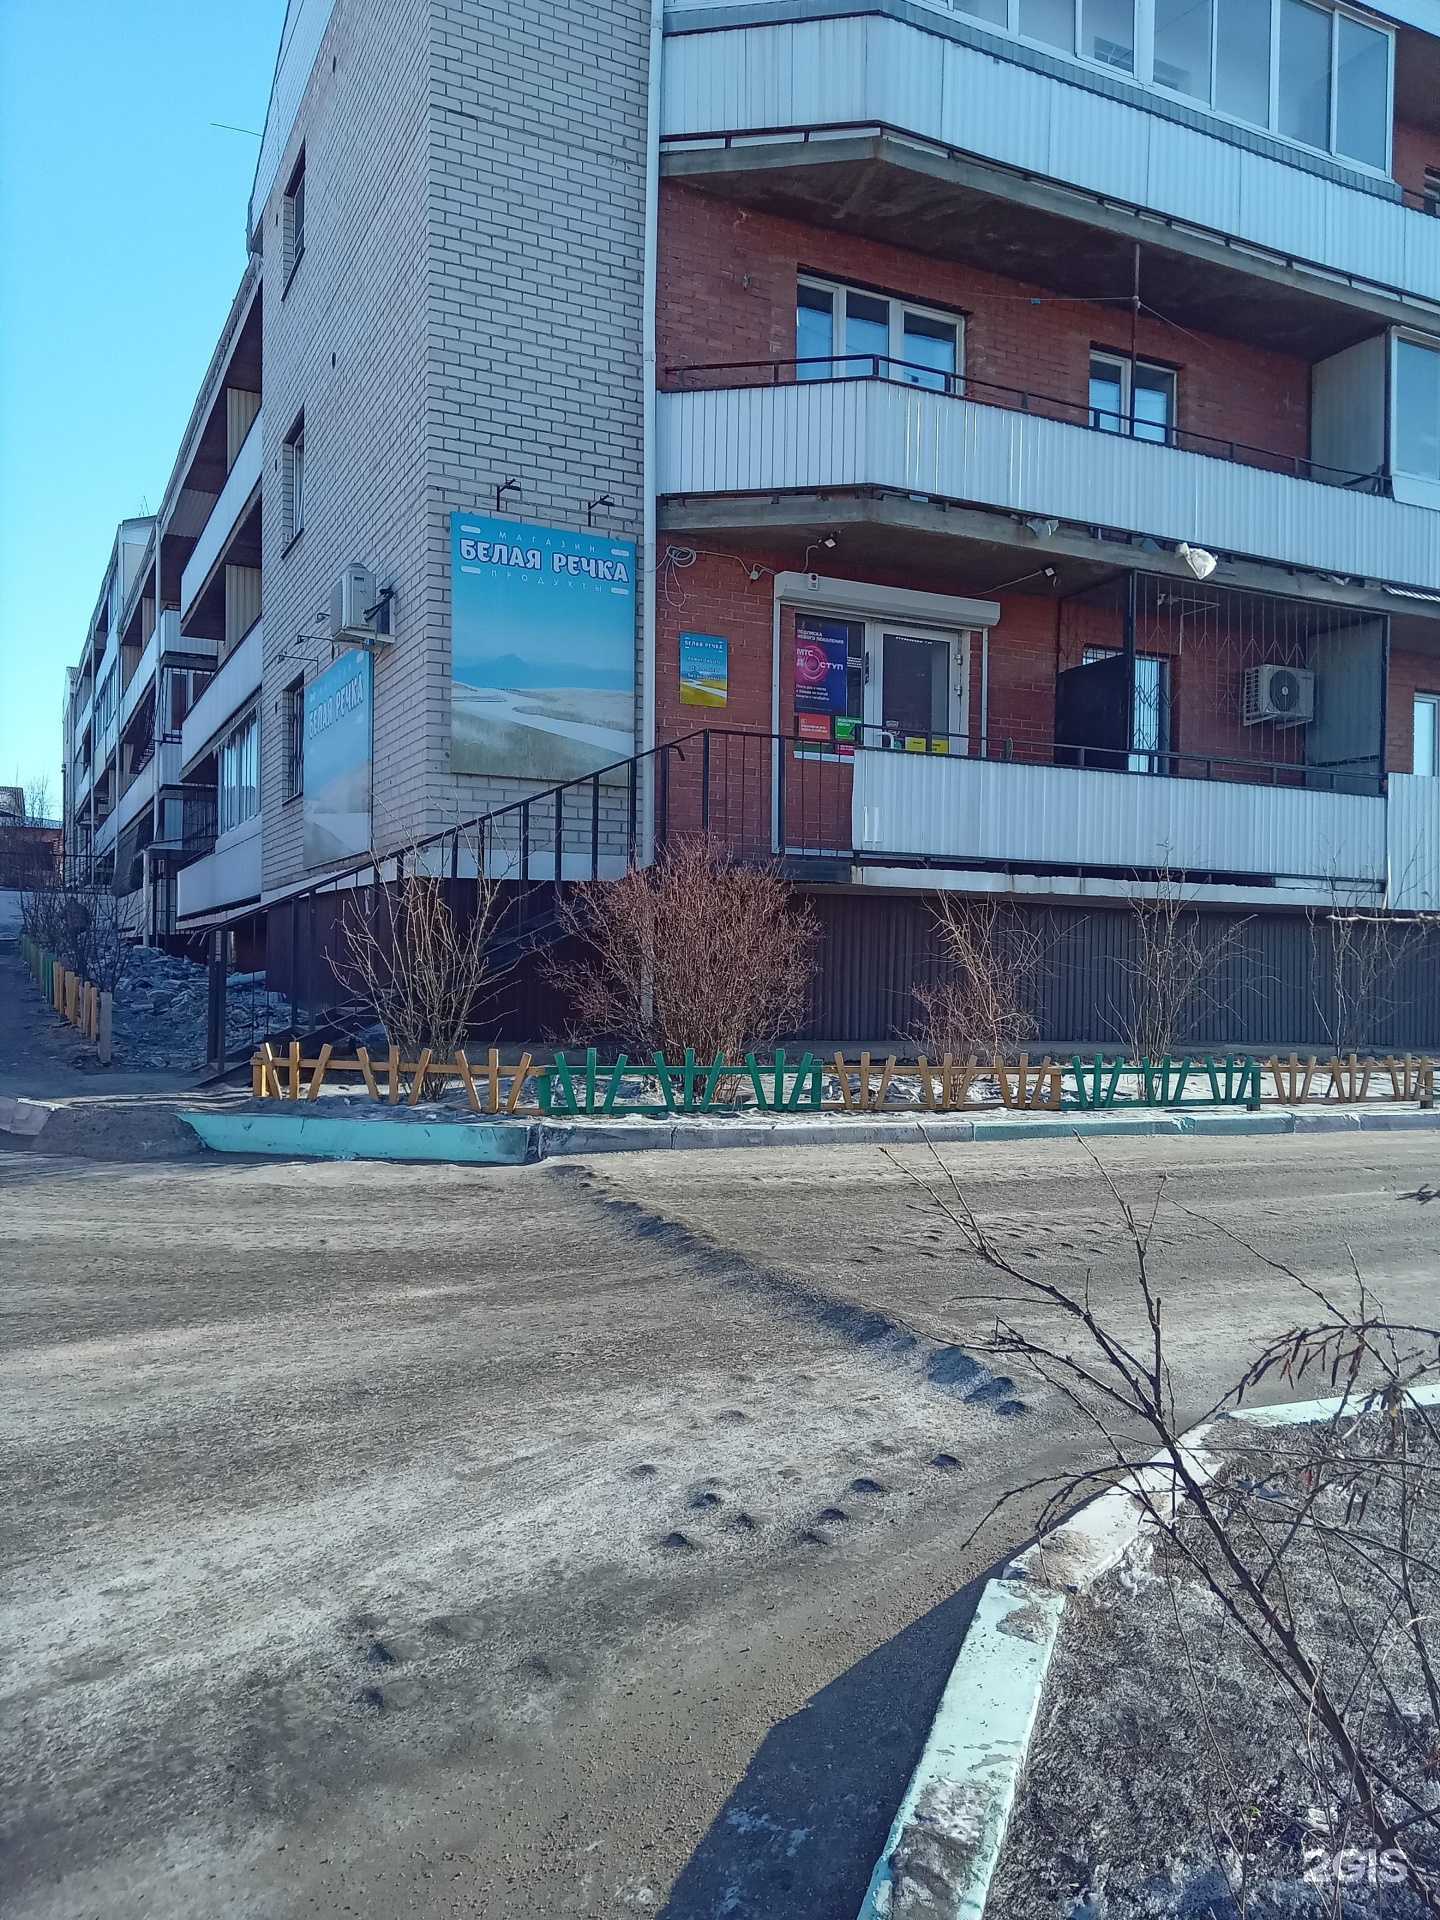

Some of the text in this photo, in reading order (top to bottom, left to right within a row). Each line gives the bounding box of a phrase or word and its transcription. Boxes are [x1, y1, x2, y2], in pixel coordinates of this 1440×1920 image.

[499, 531, 596, 553] МАГАЗИН
[459, 538, 629, 583] БЕЛАЯ РЕЧКА
[491, 569, 602, 592] ПРОДУКТЫ
[797, 648, 814, 657] МТС
[309, 696, 333, 739] БЕЛАЯ
[336, 672, 363, 721] РЕЧКА
